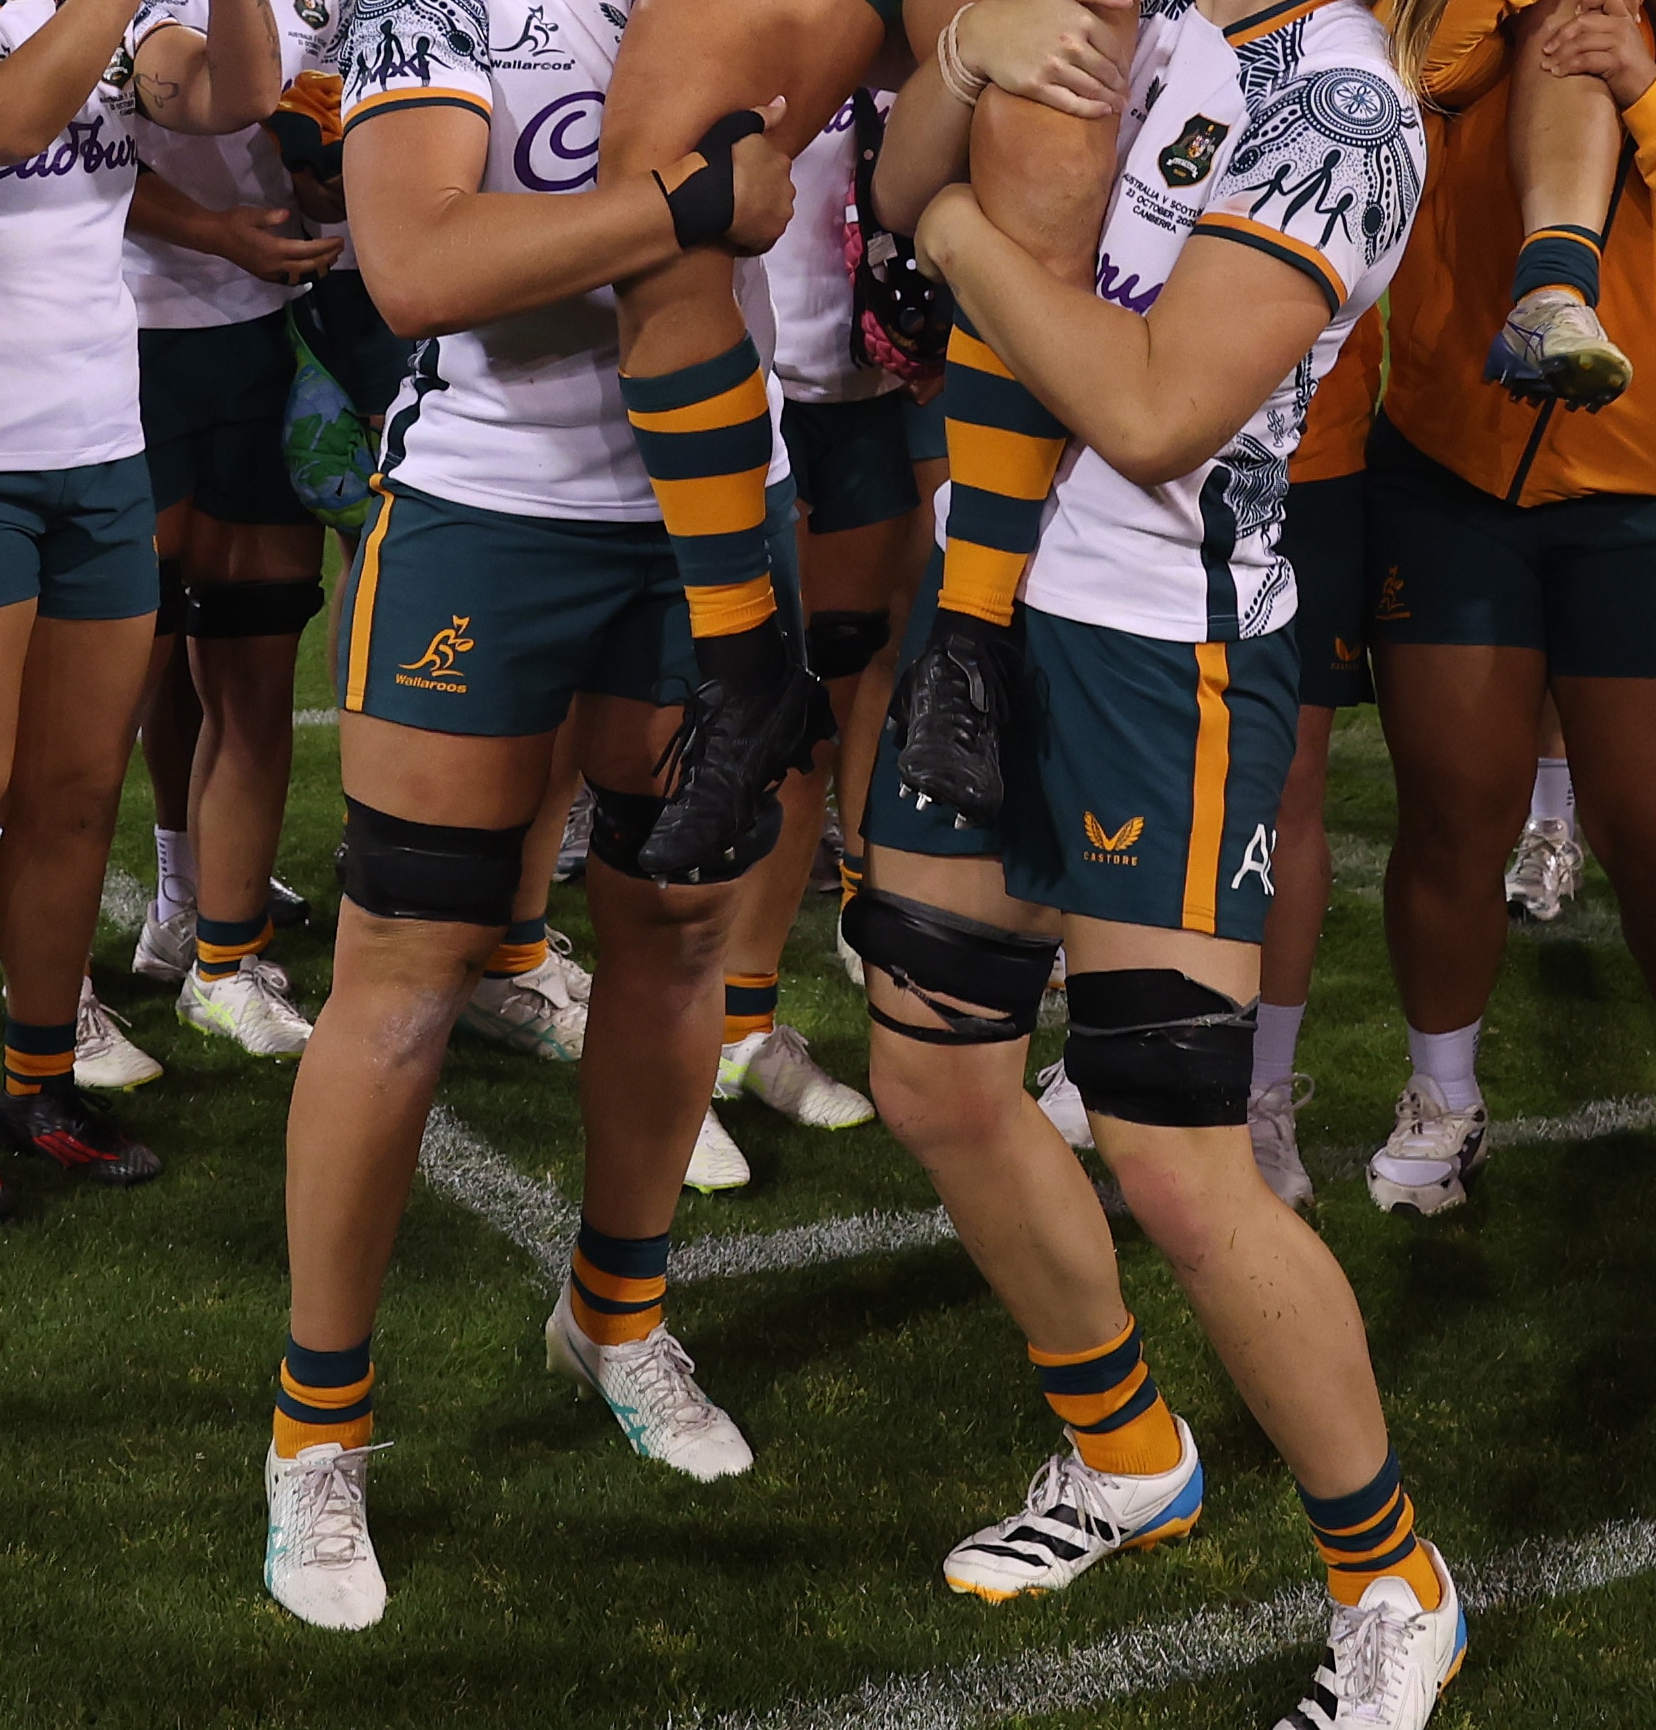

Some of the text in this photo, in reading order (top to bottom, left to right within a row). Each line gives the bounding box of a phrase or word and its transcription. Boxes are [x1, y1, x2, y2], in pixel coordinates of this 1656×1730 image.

[490, 58, 576, 71] Wallaroos
[1136, 195, 1175, 220] OCTOBER
[1132, 205, 1177, 234] CANBERRA
[396, 672, 468, 695] Wallaroos
[1083, 851, 1139, 867] CASTORE
